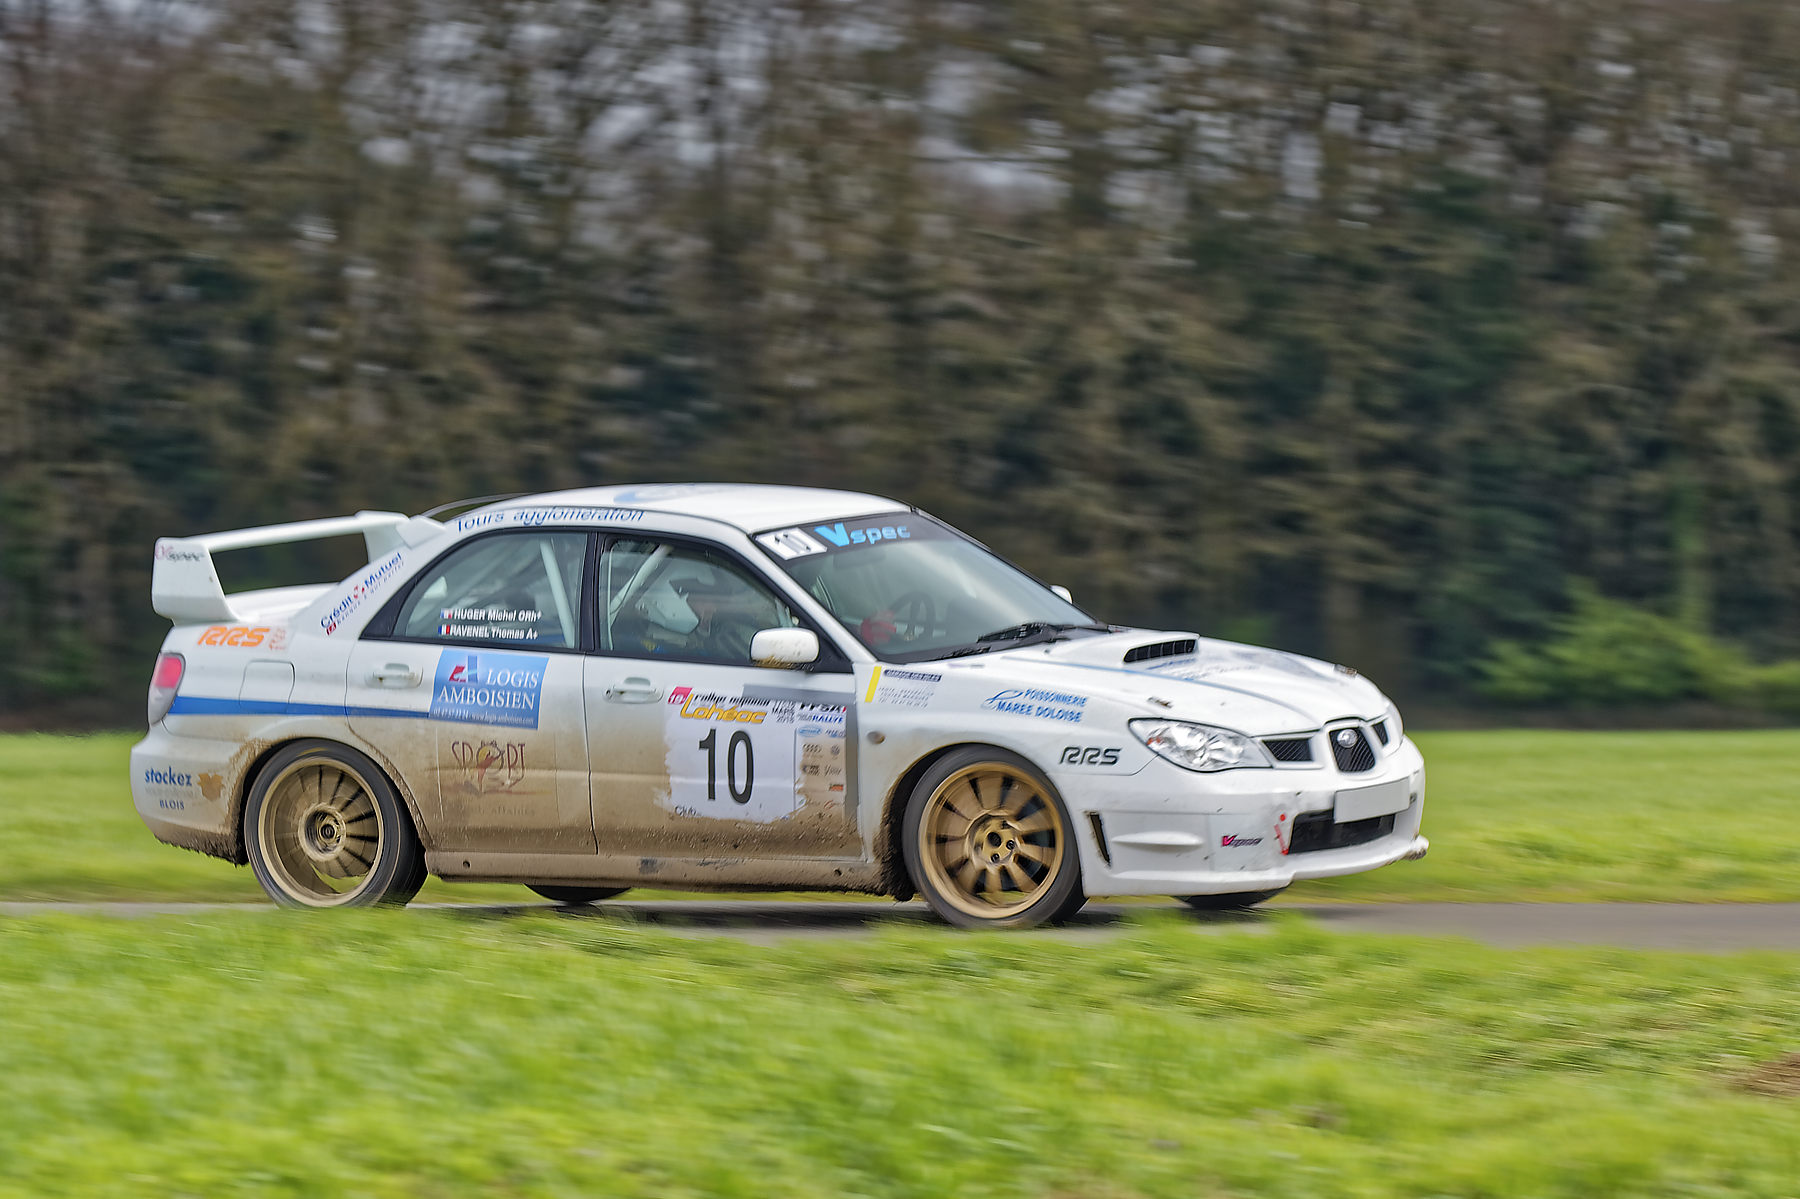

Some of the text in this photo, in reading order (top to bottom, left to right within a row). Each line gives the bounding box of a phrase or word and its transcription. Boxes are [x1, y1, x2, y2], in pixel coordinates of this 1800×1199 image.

[455, 505, 646, 532] Tours agglomeration
[814, 522, 911, 547] Vspec
[320, 551, 402, 629] Crédit Mutuel
[197, 626, 270, 647] RRS
[491, 626, 524, 640] Thomas
[487, 669, 540, 688] LOGIS
[437, 686, 536, 711] AMBOISIEN
[680, 693, 767, 724] Lohéac
[698, 728, 754, 804] 10
[1060, 746, 1122, 765] RRS
